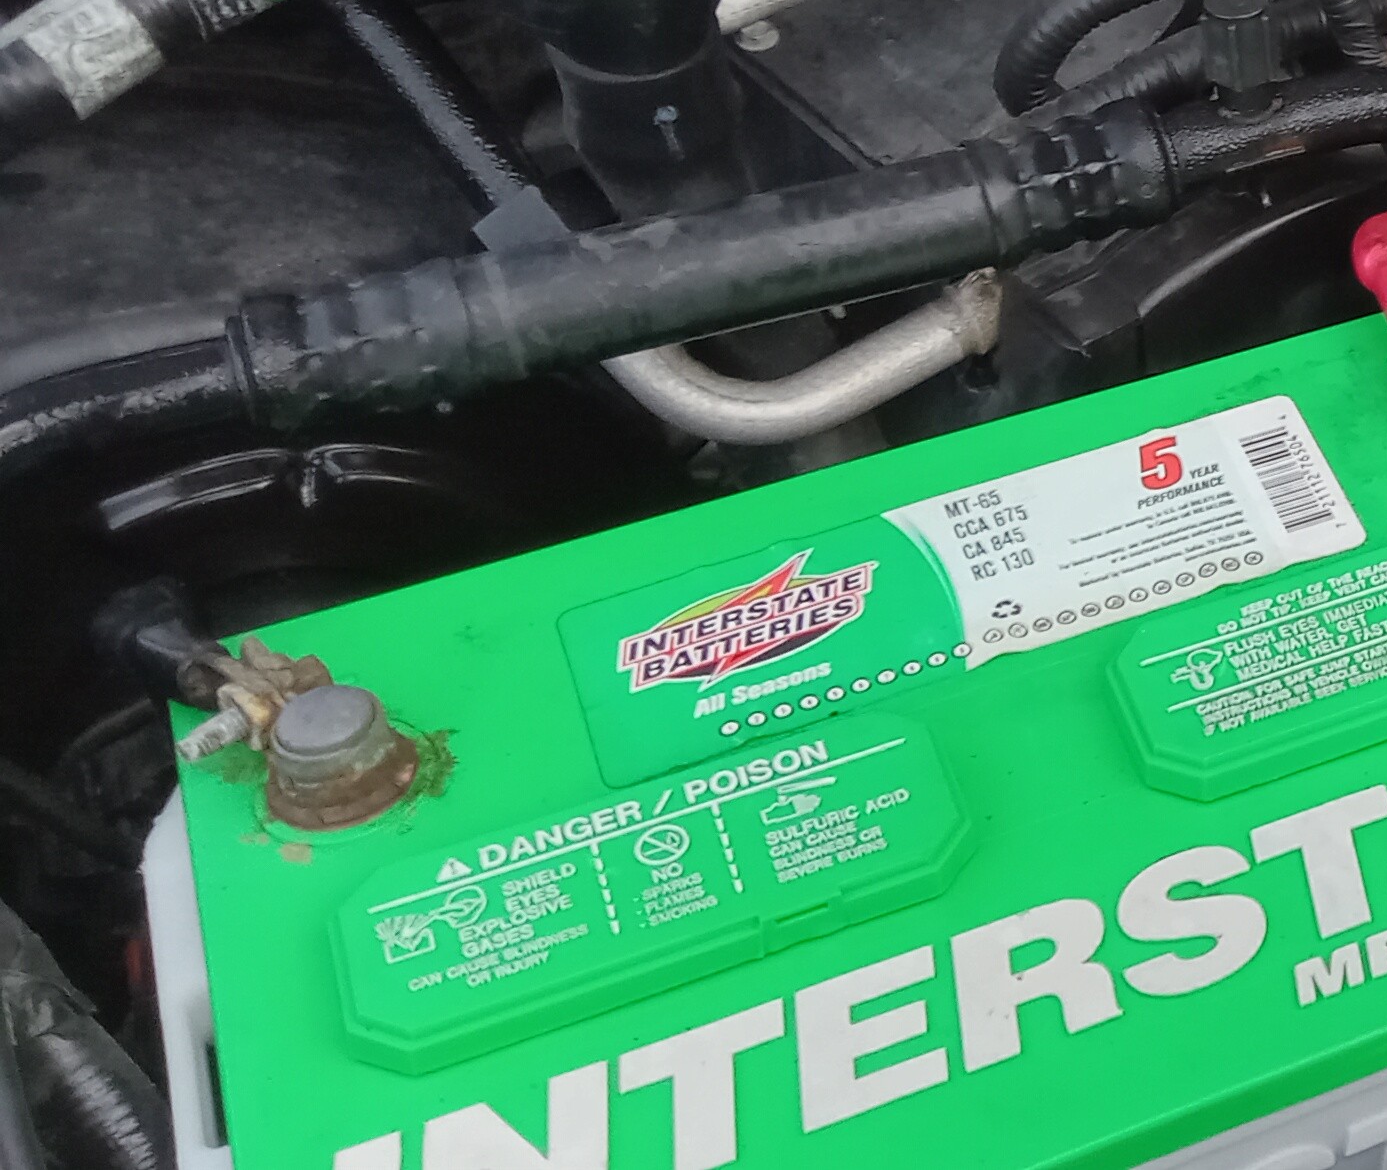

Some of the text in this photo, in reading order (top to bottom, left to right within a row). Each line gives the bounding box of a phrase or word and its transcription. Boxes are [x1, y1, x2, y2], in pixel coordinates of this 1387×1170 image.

[1138, 435, 1220, 490] 5 YEAR
[943, 488, 1002, 518] MT-65
[1137, 474, 1226, 510] PERFORMANCE
[953, 504, 1028, 540] CCA 675
[962, 528, 1026, 561] CA 845
[970, 548, 1035, 582] RC 130
[1217, 620, 1238, 635] DO
[1240, 610, 1267, 628] NOT
[1299, 590, 1331, 609] KEEP
[1333, 579, 1366, 597] VENT
[1240, 597, 1273, 617] KEEP
[1275, 588, 1302, 604] OUT
[1306, 581, 1323, 595] OF
[1326, 572, 1354, 589] THE
[627, 571, 863, 662] INTERSTATE
[1223, 630, 1276, 657] FLUSH
[1278, 615, 1319, 639] EYES
[641, 597, 855, 681] BATTERIES
[1229, 612, 1367, 668] WITH WATER. GET
[1235, 650, 1306, 681] MEDICAL
[1307, 634, 1348, 658] HELP
[694, 692, 726, 718] All
[731, 662, 832, 705] Seasons
[1201, 688, 1292, 726] INSTRUCTIONS
[1293, 682, 1309, 697] IN
[1308, 664, 1360, 690] VEHICLE
[1255, 679, 1283, 697] FOR
[1283, 667, 1316, 687] SAFE
[1319, 656, 1350, 675] JUMP
[1203, 723, 1216, 736] IF
[1218, 713, 1245, 733] NOT
[1250, 691, 1313, 723] AVAILABLE
[1313, 681, 1347, 700] SEEK
[478, 800, 644, 870] DANGER
[683, 739, 830, 805] POISON
[765, 787, 911, 847] SULFURIC ACID
[769, 820, 858, 858] CAN CAUSE
[772, 825, 883, 871] BLINDNESS OR
[777, 837, 888, 884] SEVERE BURNS
[501, 862, 577, 897] SHIELD
[642, 872, 704, 902] SPARKS
[651, 861, 684, 884] NO
[458, 893, 574, 944] EXPLOSIVE
[505, 883, 561, 913] EYES
[645, 885, 706, 915] FLAMES
[649, 895, 719, 927] SMOKING
[407, 923, 590, 992] CAN CAUSE BLINDNESS
[461, 923, 536, 959] GASES
[466, 950, 550, 989] OR INJURY
